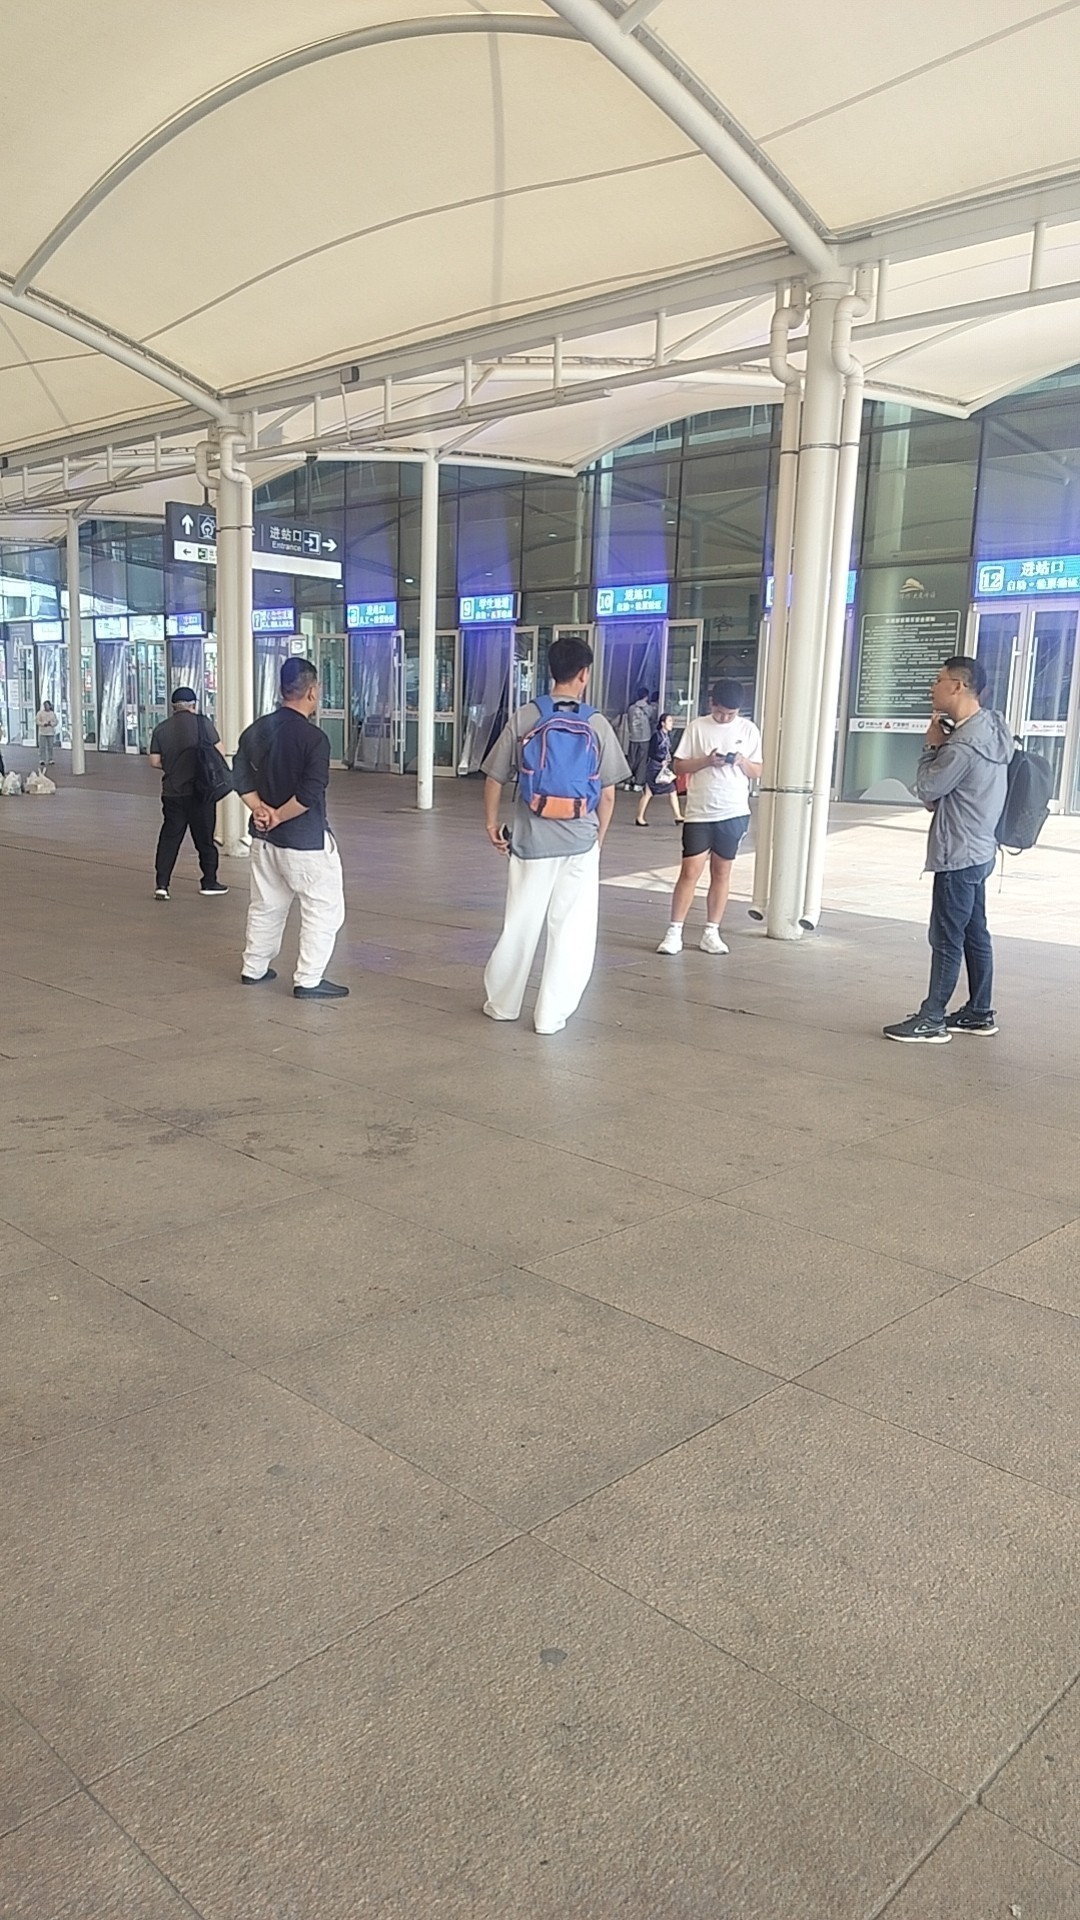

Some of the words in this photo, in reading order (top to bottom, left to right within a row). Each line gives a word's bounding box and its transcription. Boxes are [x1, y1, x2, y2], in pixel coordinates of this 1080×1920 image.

[269, 525, 302, 542] 进站口
[271, 540, 302, 552] Entrance
[982, 571, 1001, 589] 12
[463, 601, 471, 617] 9
[599, 594, 611, 609] 10
